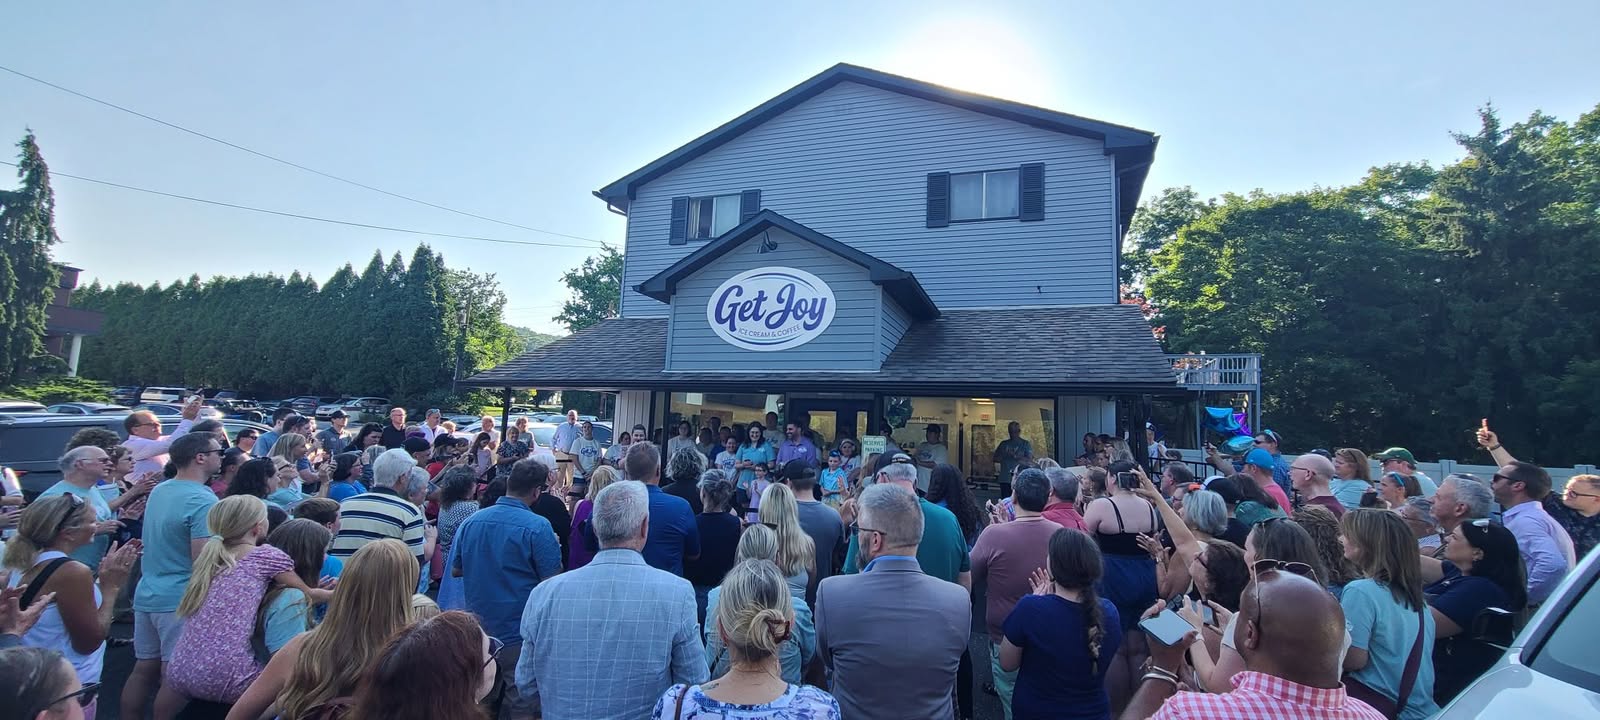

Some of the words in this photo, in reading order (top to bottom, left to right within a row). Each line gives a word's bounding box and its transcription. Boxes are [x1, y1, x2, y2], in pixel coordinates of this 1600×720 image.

[715, 285, 768, 332] Get
[765, 283, 827, 331] Joy
[739, 328, 748, 336] ICE
[749, 329, 771, 337] CREAM
[771, 329, 777, 337] &
[777, 325, 801, 337] COFFEE
